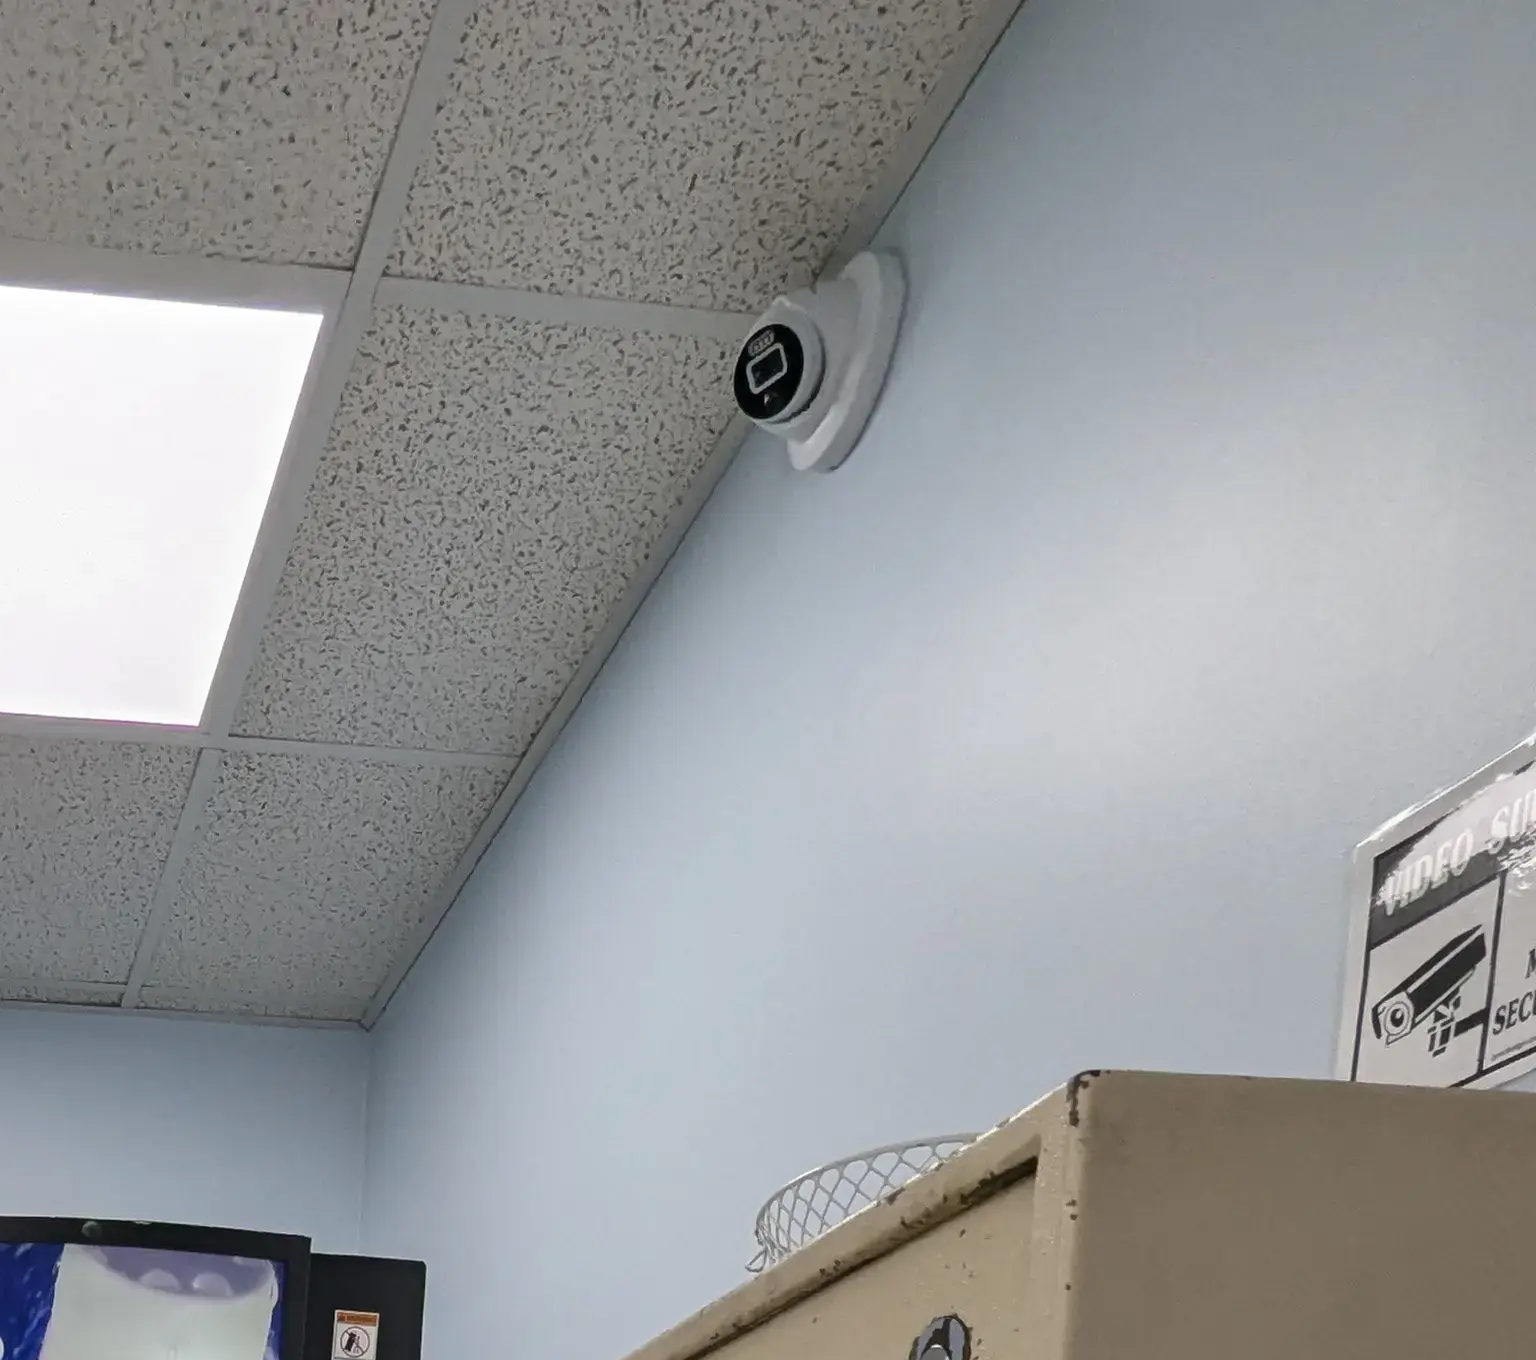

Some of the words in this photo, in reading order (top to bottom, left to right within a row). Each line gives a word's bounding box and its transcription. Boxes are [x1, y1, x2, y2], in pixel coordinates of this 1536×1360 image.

[1487, 787, 1536, 854] SU
[1380, 831, 1474, 917] VIDEO
[1492, 989, 1536, 1036] SEC
